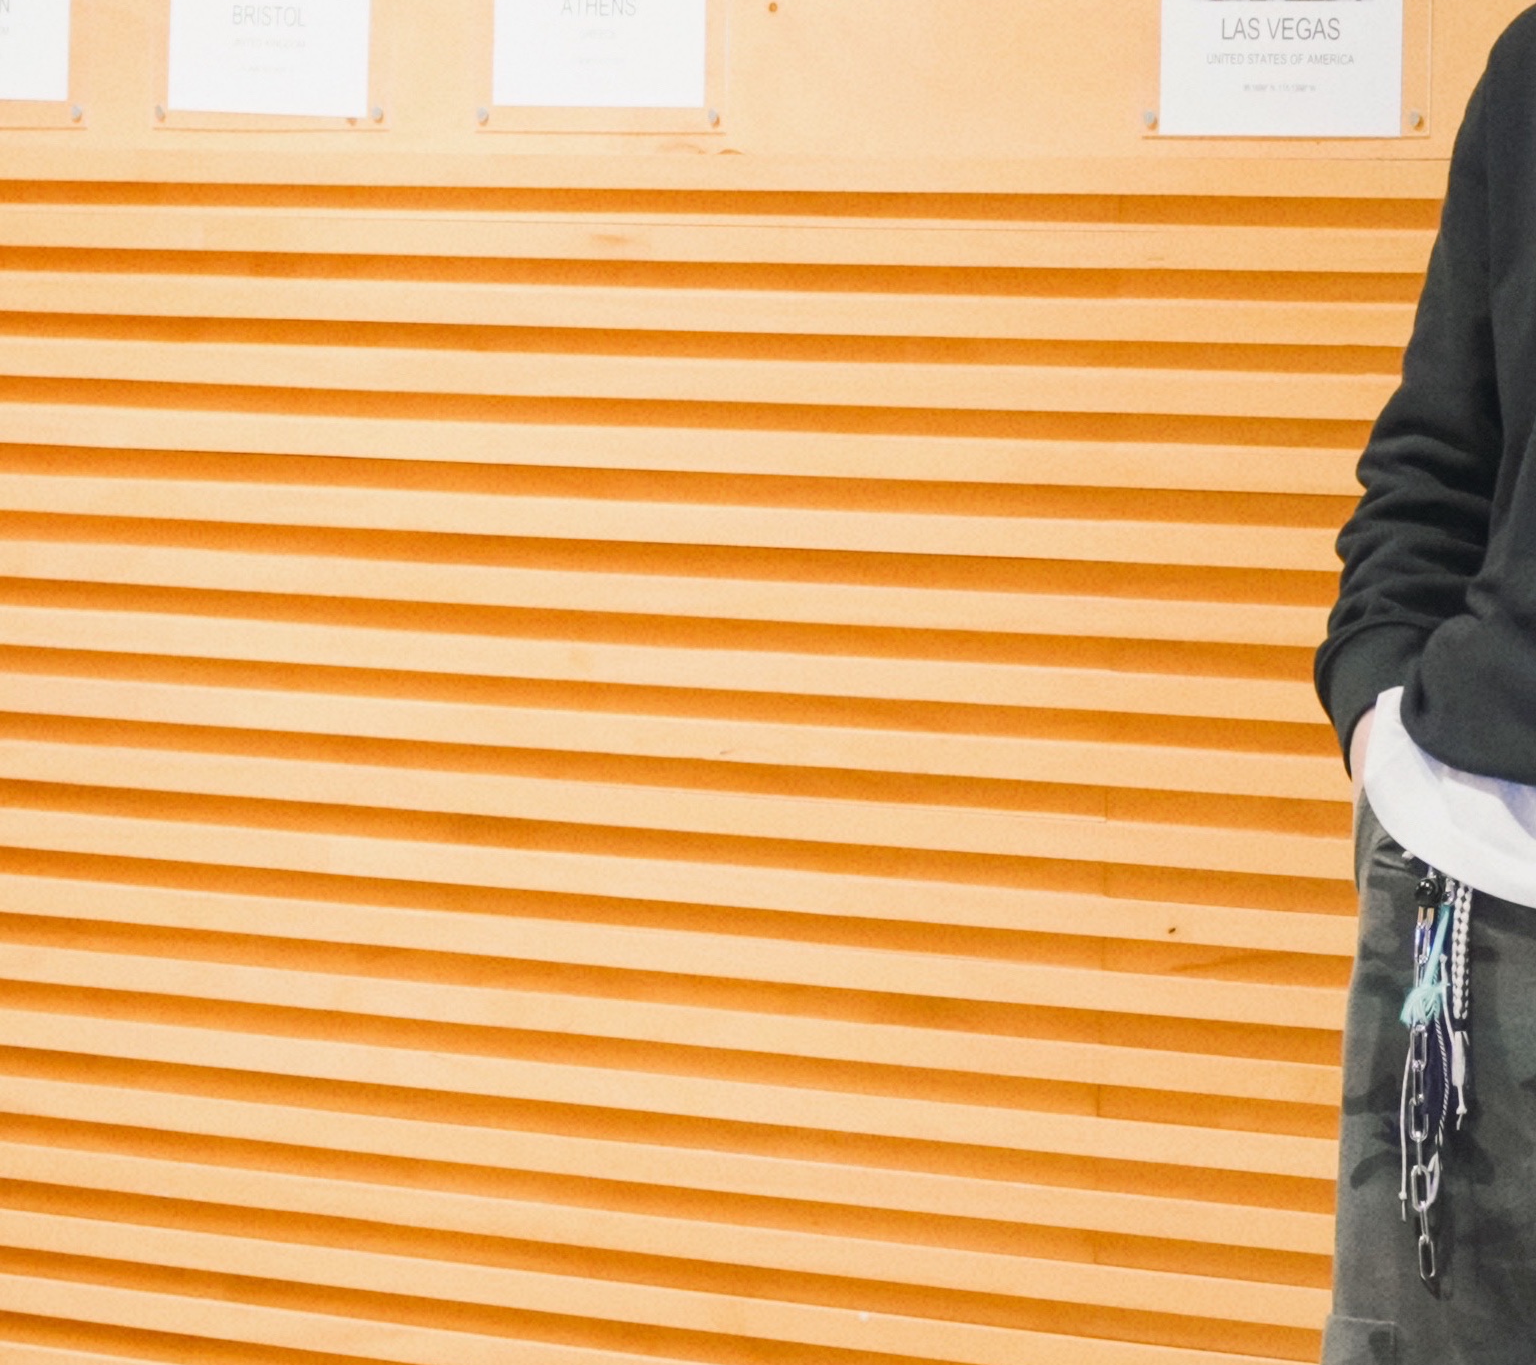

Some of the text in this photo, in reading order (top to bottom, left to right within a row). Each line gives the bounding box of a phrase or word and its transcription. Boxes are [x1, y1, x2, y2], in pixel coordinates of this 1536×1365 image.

[232, 4, 306, 28] BRISTOL
[1220, 17, 1341, 41] LAS VEGAS
[1206, 53, 1355, 65] UNITED STATES OF AMERICA
